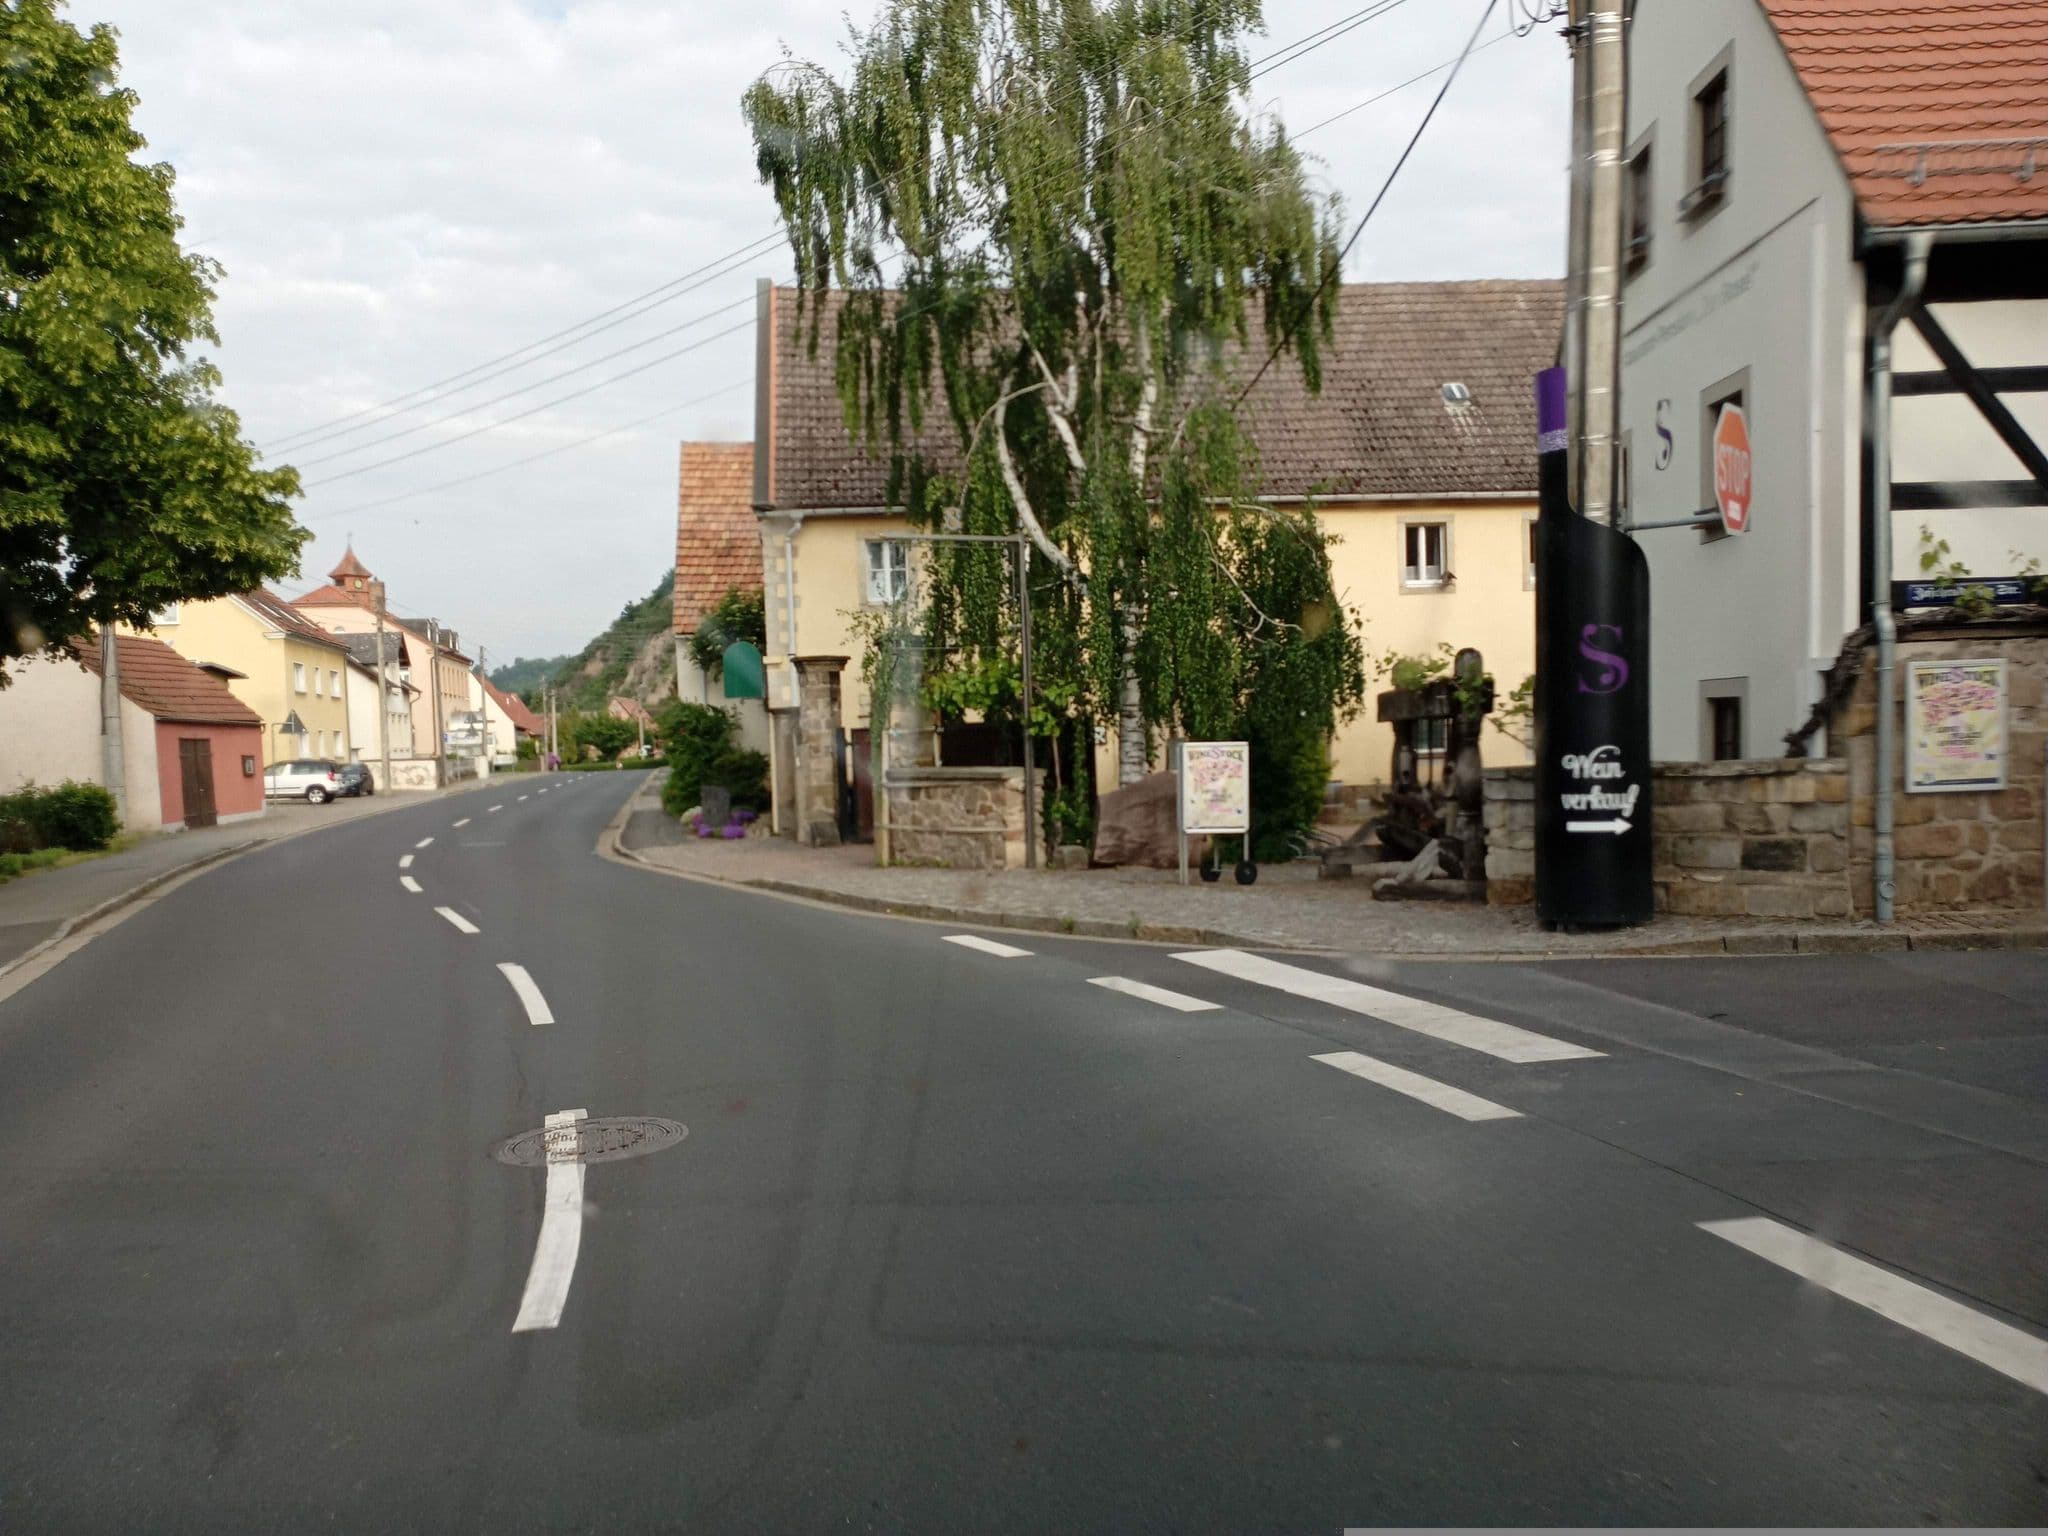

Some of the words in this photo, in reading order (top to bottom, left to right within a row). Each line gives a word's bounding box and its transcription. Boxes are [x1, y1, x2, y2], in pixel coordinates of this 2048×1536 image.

[1718, 442, 1751, 497] STOP
[1578, 623, 1630, 694] S
[1561, 744, 1626, 779] Wein
[1561, 783, 1640, 818] verkauf
